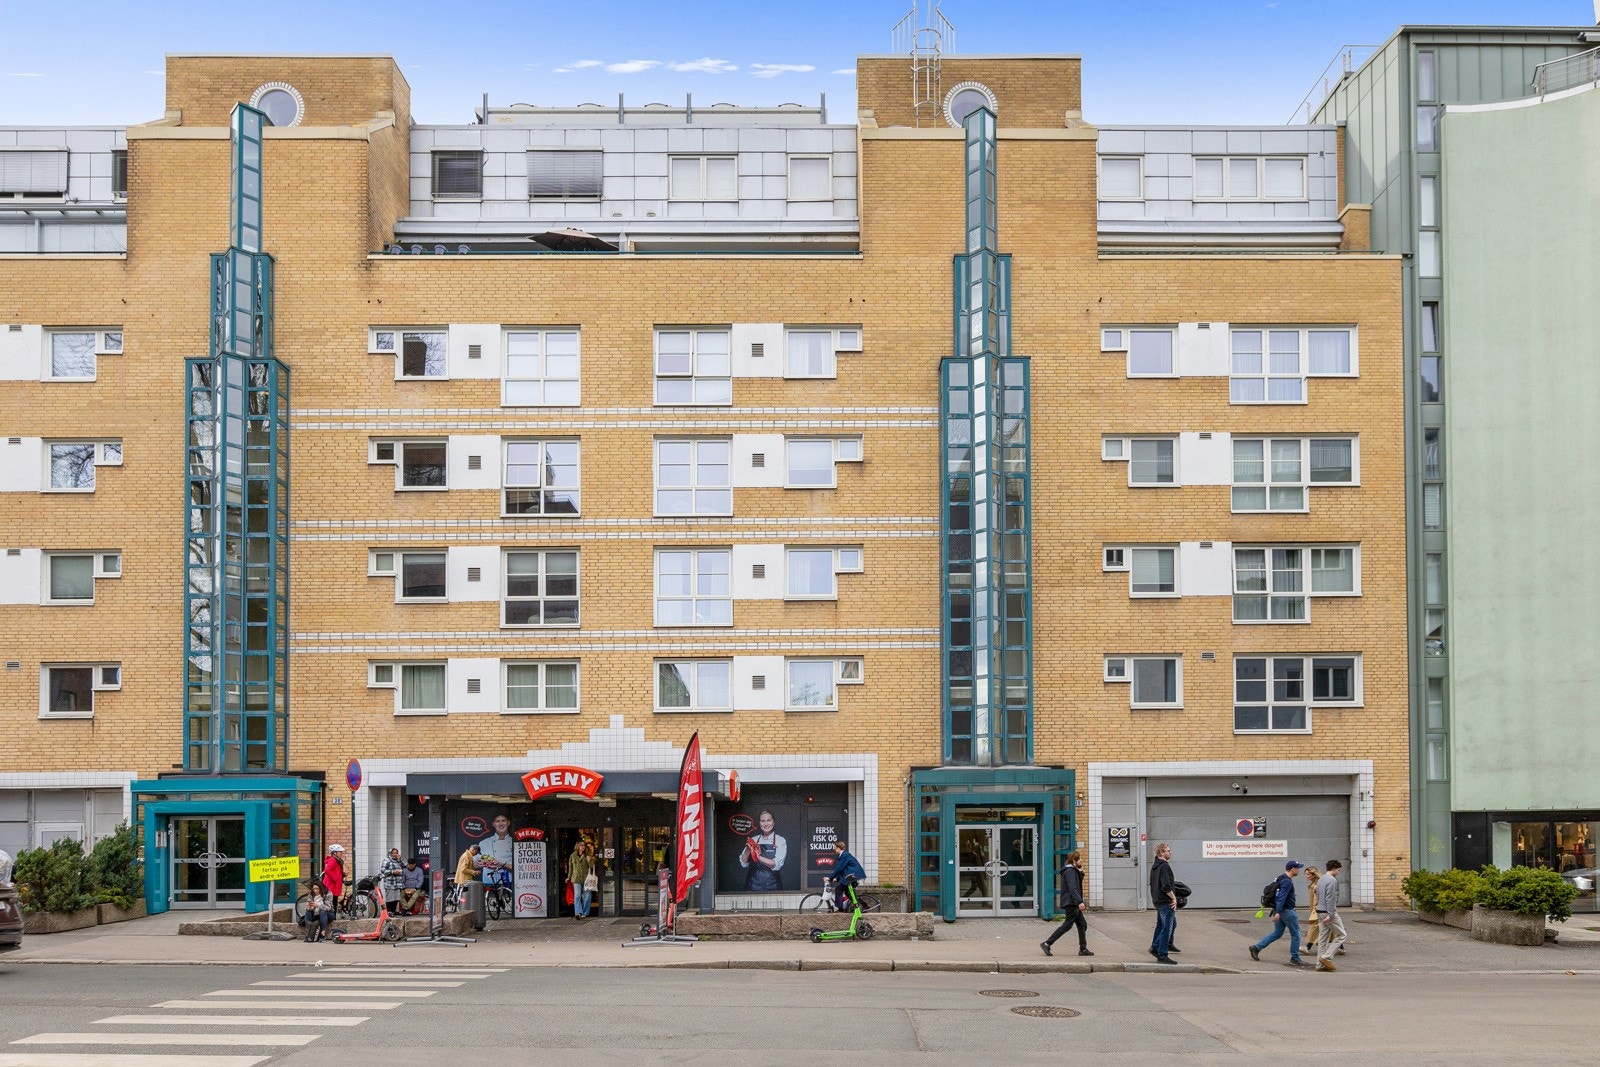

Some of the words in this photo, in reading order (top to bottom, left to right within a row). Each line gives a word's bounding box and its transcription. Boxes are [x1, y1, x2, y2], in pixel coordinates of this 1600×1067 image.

[530, 772, 593, 791] MENY
[518, 830, 541, 838] MENY
[683, 782, 701, 881] MENY
